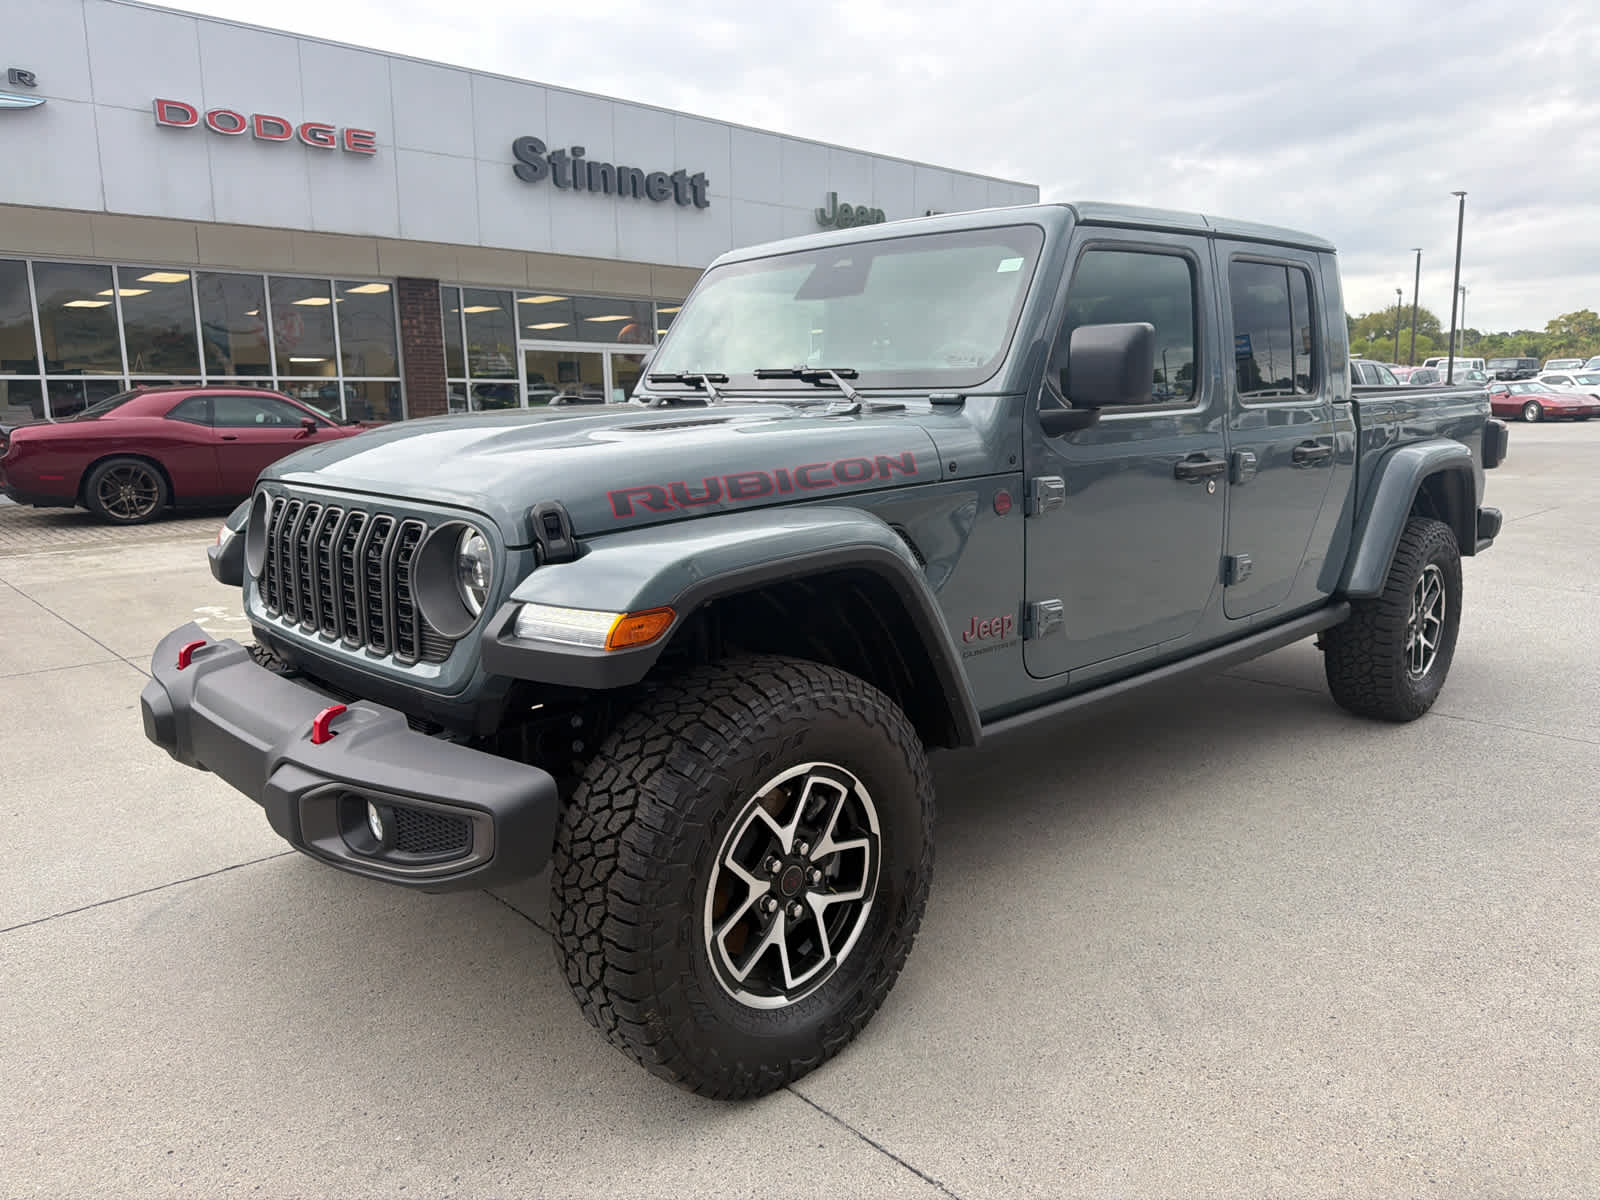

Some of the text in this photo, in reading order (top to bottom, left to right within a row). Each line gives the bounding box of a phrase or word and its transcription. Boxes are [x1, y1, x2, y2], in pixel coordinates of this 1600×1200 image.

[153, 98, 377, 157] DODGE
[512, 136, 710, 208] Stinnett
[607, 452, 918, 519] RUBICON
[962, 614, 1013, 645] Jeep
